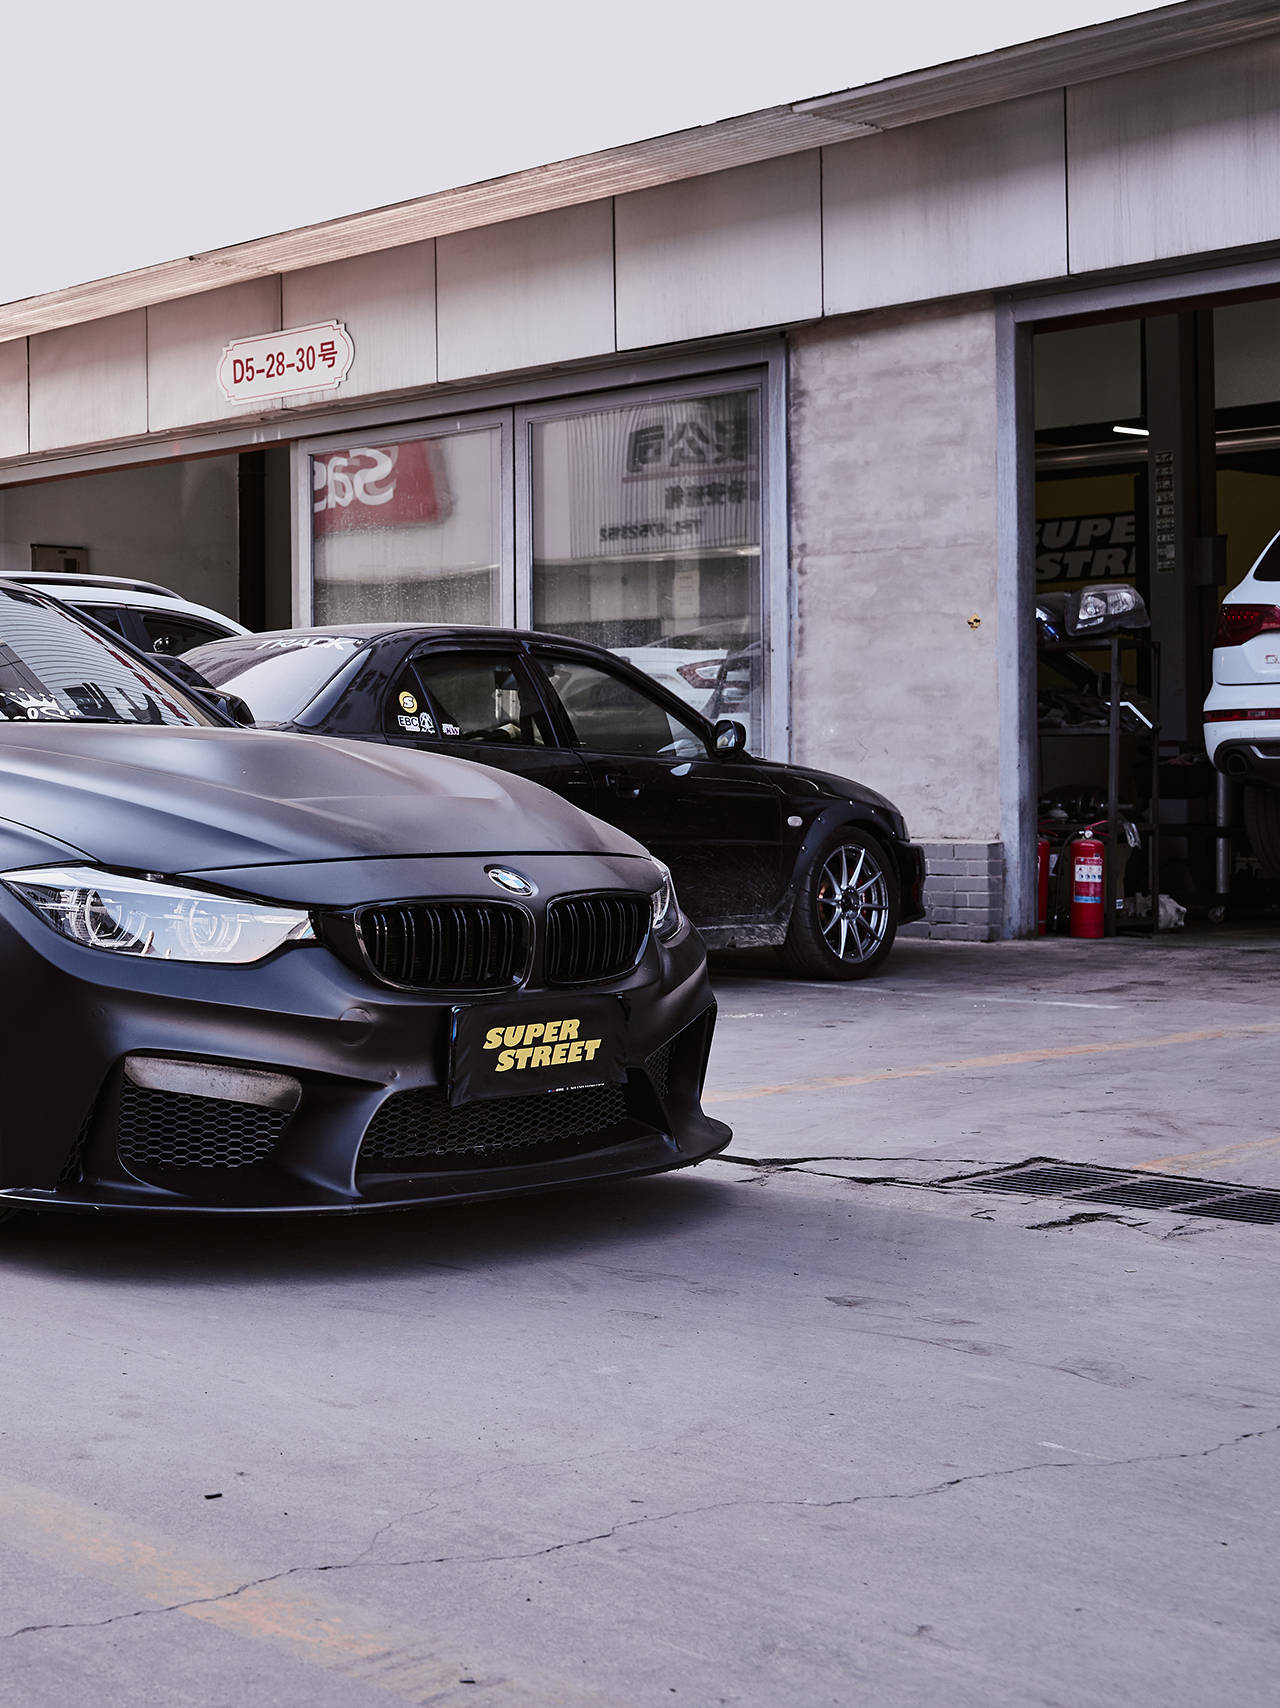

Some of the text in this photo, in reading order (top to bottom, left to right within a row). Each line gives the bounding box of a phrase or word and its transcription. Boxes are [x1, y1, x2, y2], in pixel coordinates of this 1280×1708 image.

[232, 340, 338, 385] D5-28-30号
[1036, 515, 1136, 549] UPE
[399, 716, 419, 727] EBC
[483, 1019, 581, 1049] SUPER
[494, 1039, 602, 1072] STREET
